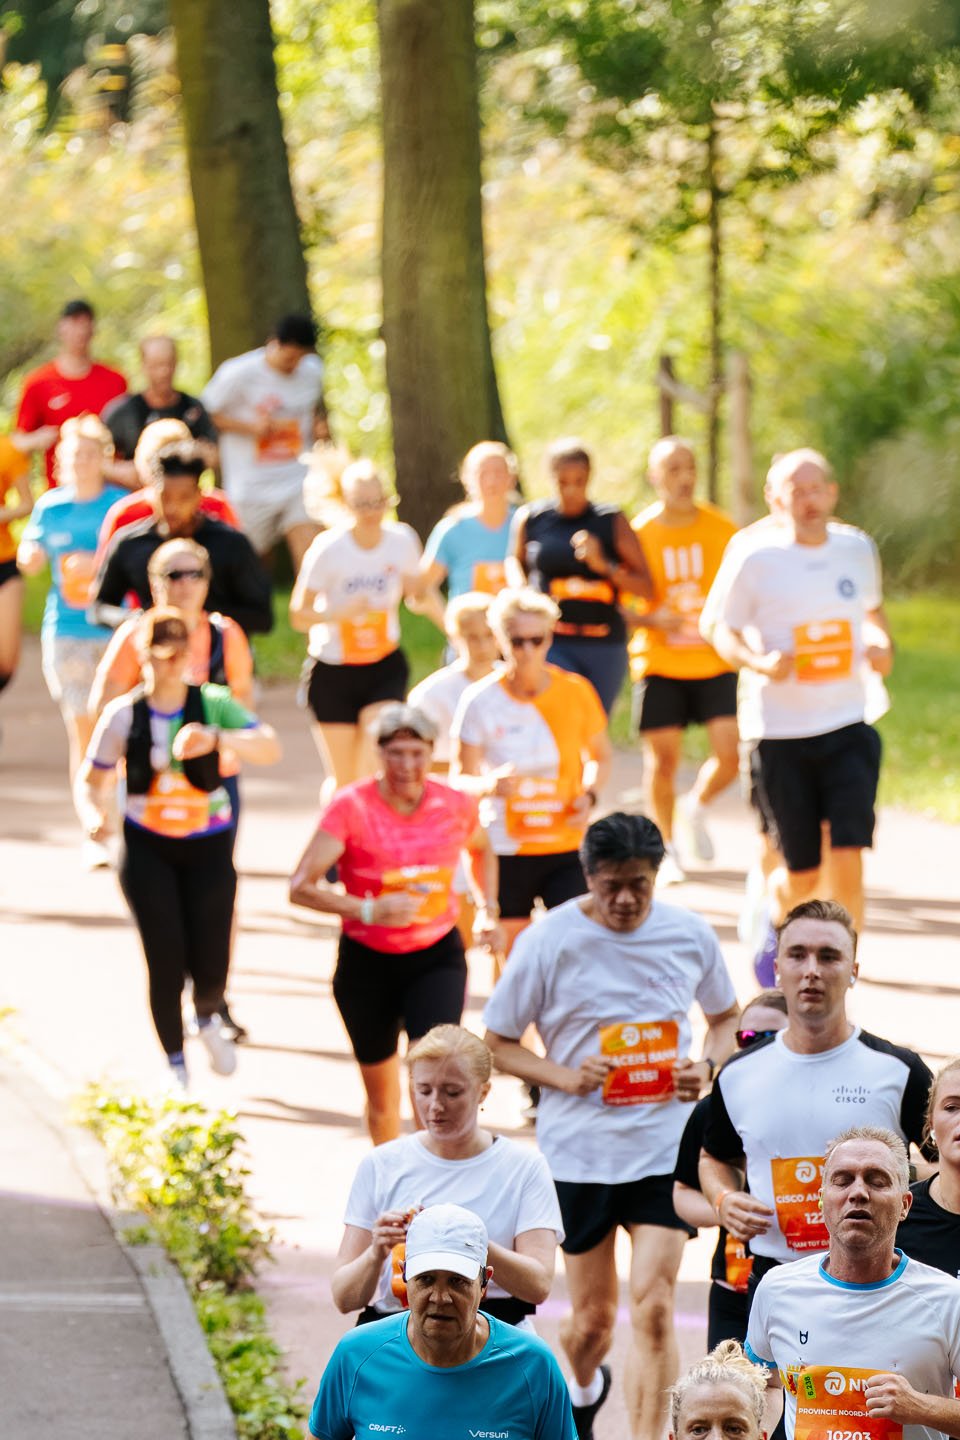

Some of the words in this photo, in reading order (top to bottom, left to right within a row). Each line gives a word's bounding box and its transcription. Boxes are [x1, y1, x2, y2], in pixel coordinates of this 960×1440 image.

[835, 1096, 866, 1104] CISCO
[776, 1195, 804, 1203] CISCO
[798, 1408, 838, 1416] PROVINCIE
[368, 1423, 397, 1433] CRAFT
[469, 1429, 509, 1439] Versuni
